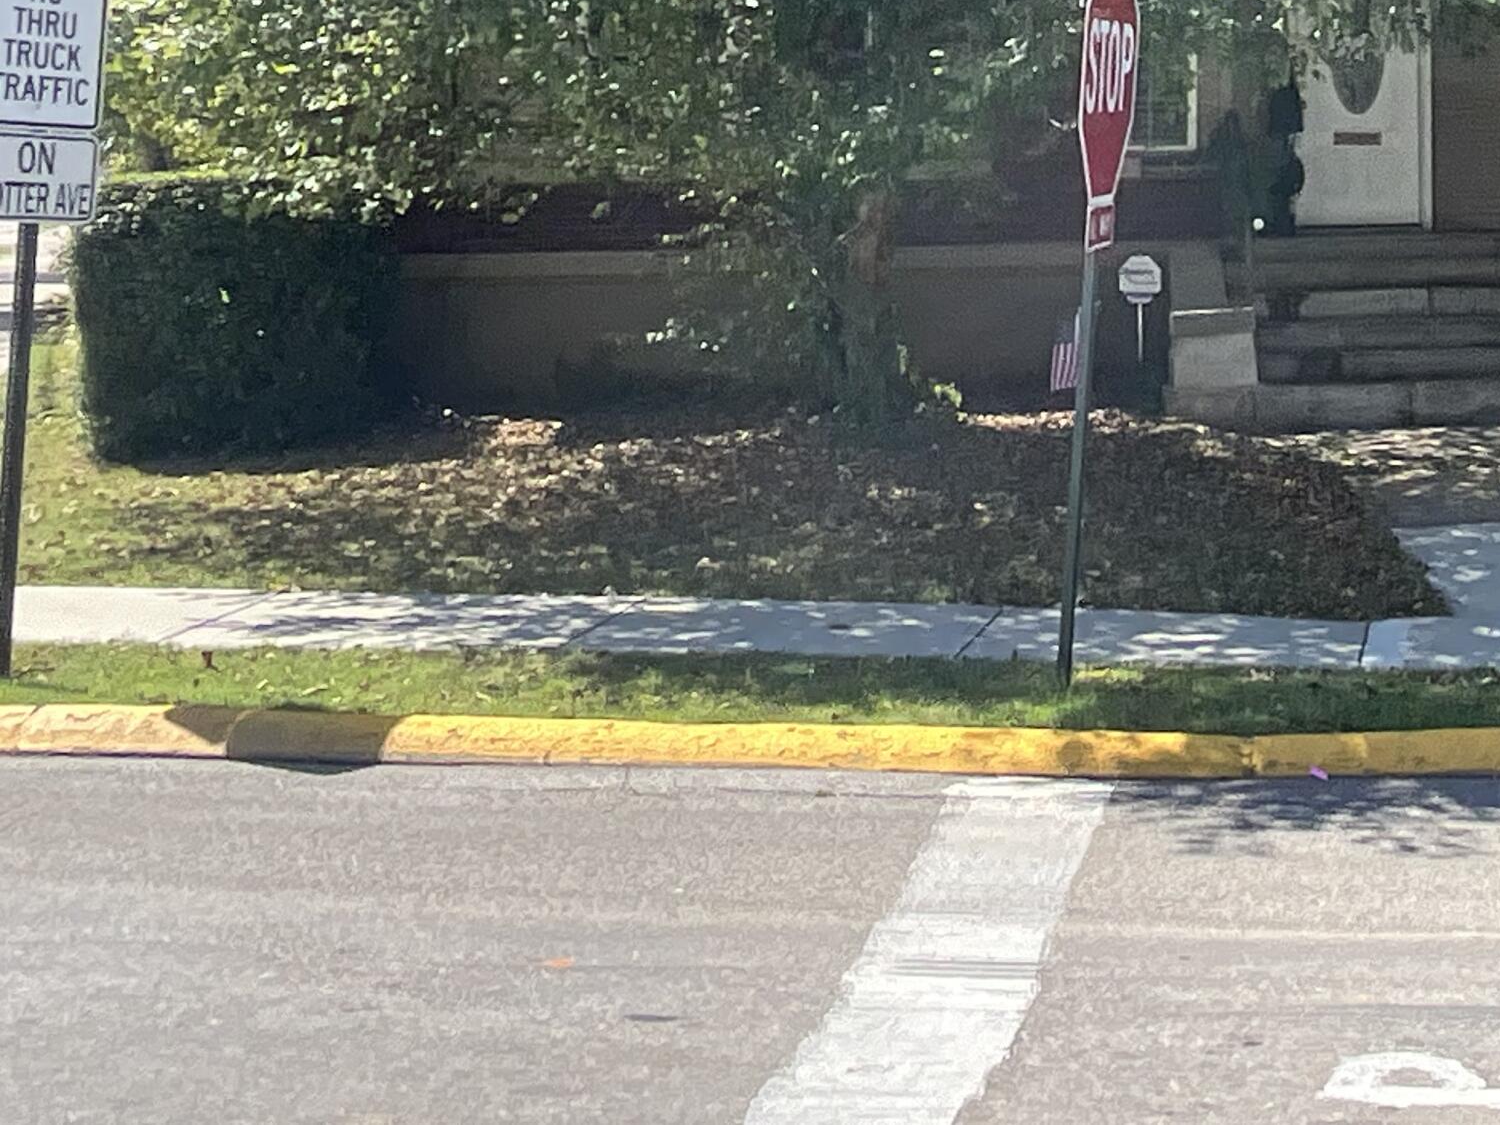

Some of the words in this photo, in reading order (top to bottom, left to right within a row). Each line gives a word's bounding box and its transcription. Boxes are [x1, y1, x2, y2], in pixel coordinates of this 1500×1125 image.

[13, 6, 77, 39] THRU
[4, 39, 81, 71] TRUCK
[1086, 18, 1134, 114] STOP
[18, 141, 56, 175] ON
[0, 181, 49, 214] TTER
[54, 182, 90, 215] AVE
